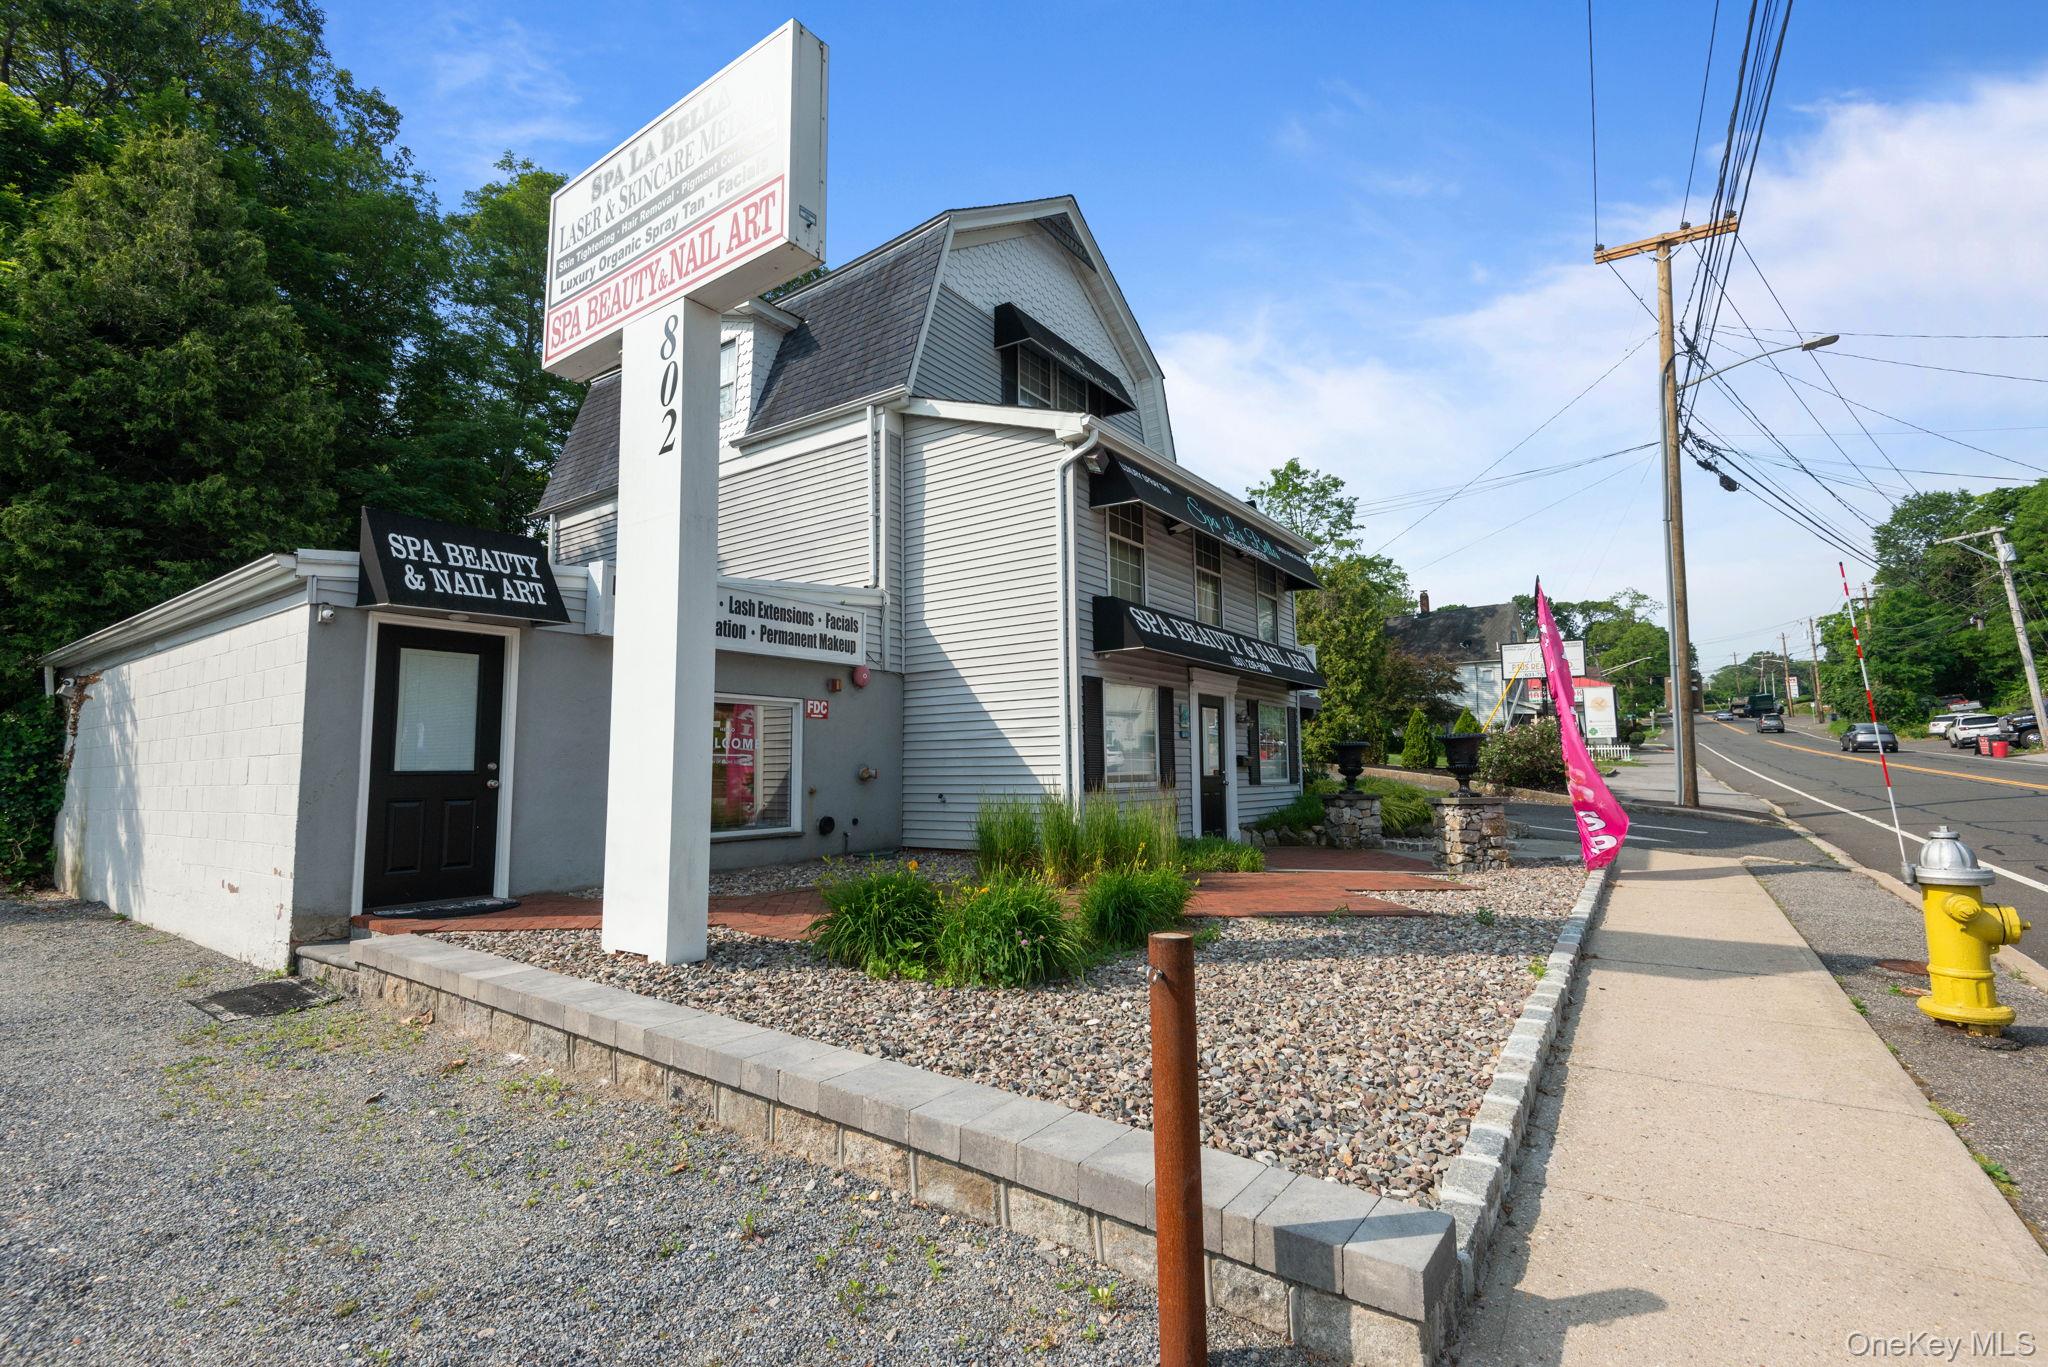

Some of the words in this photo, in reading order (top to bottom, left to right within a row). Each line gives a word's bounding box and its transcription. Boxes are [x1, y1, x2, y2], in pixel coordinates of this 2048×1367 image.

[591, 163, 625, 203] SPA
[629, 139, 657, 178] LA
[661, 85, 732, 155] BELLA
[558, 257, 575, 273] Skin
[576, 232, 615, 261] Tightening
[621, 216, 638, 235] Hair
[640, 190, 674, 222] Removal
[681, 163, 718, 195] Pigment
[559, 206, 601, 254] LASER
[605, 198, 615, 224] &
[619, 141, 695, 214] SKINCARE
[560, 265, 596, 295] Luxury
[599, 237, 642, 272] Organic
[645, 212, 679, 244] Spray
[682, 196, 705, 219] Tan
[717, 157, 769, 199] Facials
[551, 305, 582, 349] SPA
[726, 190, 776, 255] ART
[658, 314, 679, 456] 802
[1186, 496, 1221, 533] Spa
[387, 532, 441, 565] SPA
[442, 541, 541, 579] BEAUTY
[404, 564, 426, 591] &
[429, 567, 497, 599] NAIL
[502, 577, 548, 606] ART
[715, 619, 746, 640] ation
[760, 624, 817, 649] Permanent
[819, 632, 857, 655] Makeup
[728, 595, 756, 618] Lash
[758, 600, 814, 627] Extensions
[825, 612, 859, 634] Facials
[1129, 606, 1176, 638] SPA
[1169, 618, 1243, 656] BEAUTY
[1240, 638, 1258, 660] &
[1251, 641, 1293, 667] NAIL
[1286, 652, 1315, 674] ART
[807, 700, 827, 714] FDC
[714, 738, 760, 750] LCOME
